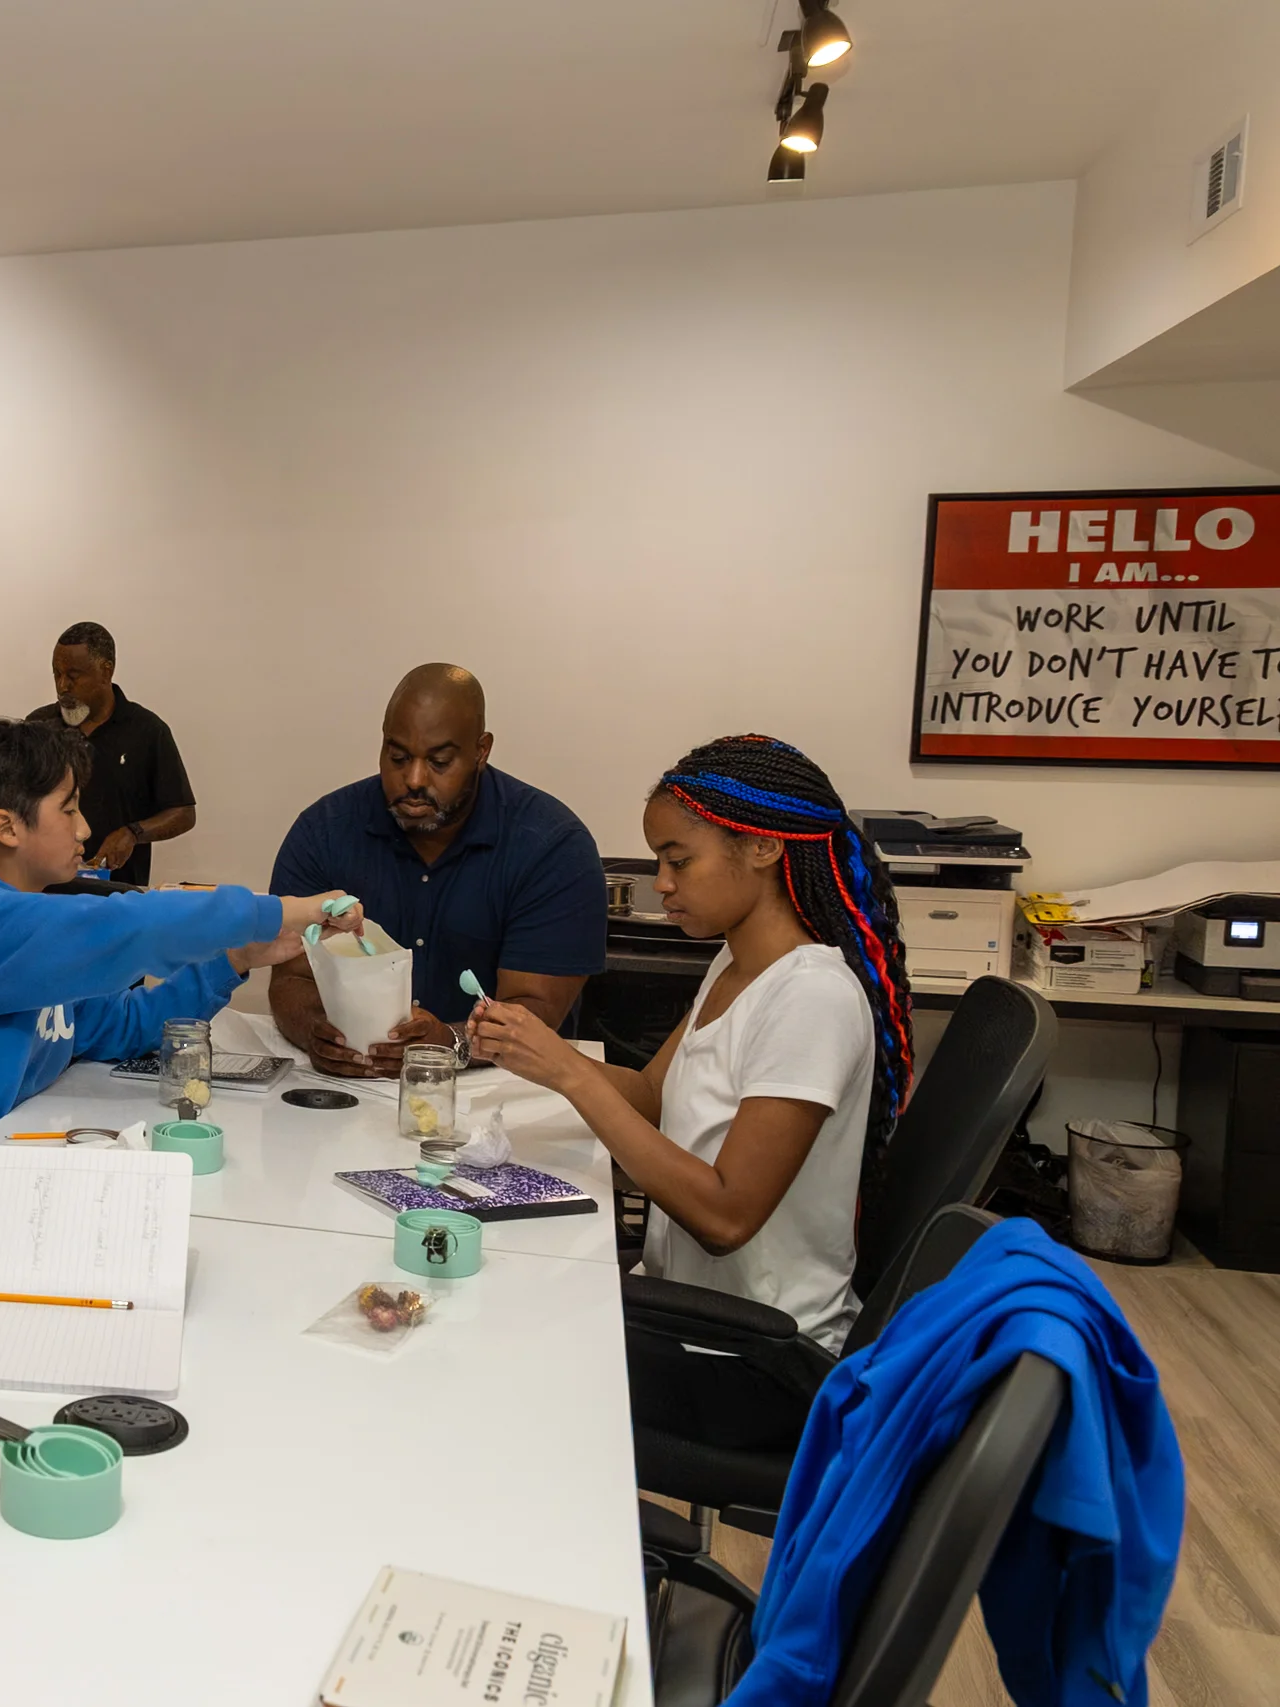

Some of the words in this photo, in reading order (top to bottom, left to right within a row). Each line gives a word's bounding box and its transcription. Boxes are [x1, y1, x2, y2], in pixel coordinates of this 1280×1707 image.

[1008, 507, 1255, 553] HELLO
[1069, 562, 1080, 582] I
[1094, 562, 1200, 583] AM...
[1016, 603, 1105, 633] WORK
[1136, 600, 1236, 635] UNTIL
[952, 648, 1012, 679] YOU
[1028, 646, 1138, 681] DON'T
[1144, 648, 1240, 681] HAVE
[1252, 648, 1280, 679] T
[930, 691, 1103, 728] INTRODUCE
[1132, 694, 1280, 732] YOURSEL
[501, 1621, 521, 1644] THE
[483, 1645, 512, 1702] ICONICS
[524, 1633, 568, 1707] cliganic
